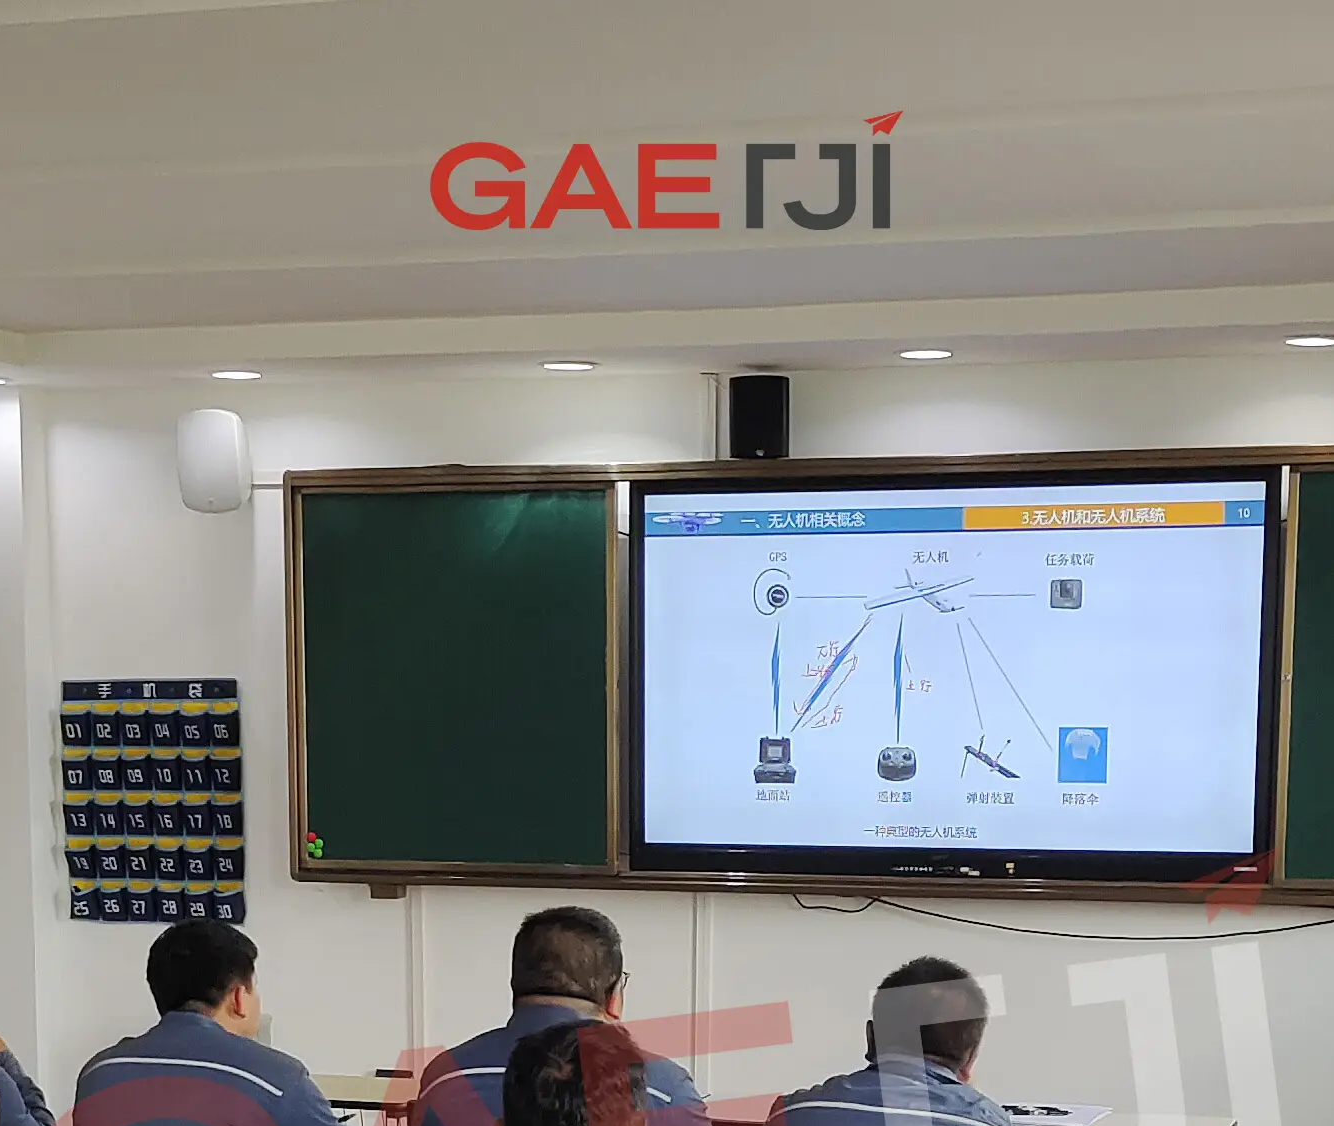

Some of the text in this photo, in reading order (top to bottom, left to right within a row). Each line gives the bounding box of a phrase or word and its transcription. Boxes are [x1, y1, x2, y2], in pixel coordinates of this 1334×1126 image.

[740, 511, 866, 529] 一、无人机相关概念
[1021, 507, 1166, 526] 3.无人机和无人机系统
[1237, 507, 1251, 519] 10
[769, 551, 788, 562] GPS
[912, 550, 949, 564] 无人机
[1045, 553, 1095, 567] 任务载荷
[65, 723, 228, 738] 01 02 03 04 05 06
[67, 768, 228, 783] 07 08 09 10 11 12
[755, 789, 791, 802] 地面站
[877, 791, 913, 804] 遥控器
[966, 791, 1015, 805] 弹射装置
[1061, 792, 1100, 806] 降落伞
[70, 813, 86, 826] 13
[100, 813, 115, 828] 14
[128, 814, 144, 827] 15
[158, 814, 172, 827] 16
[188, 814, 201, 828] 17
[863, 825, 978, 839] 一种典型的无人机系统
[73, 856, 232, 873] 19 20 21 22 23 24
[72, 898, 232, 918] 25 26 27 28 29 30
